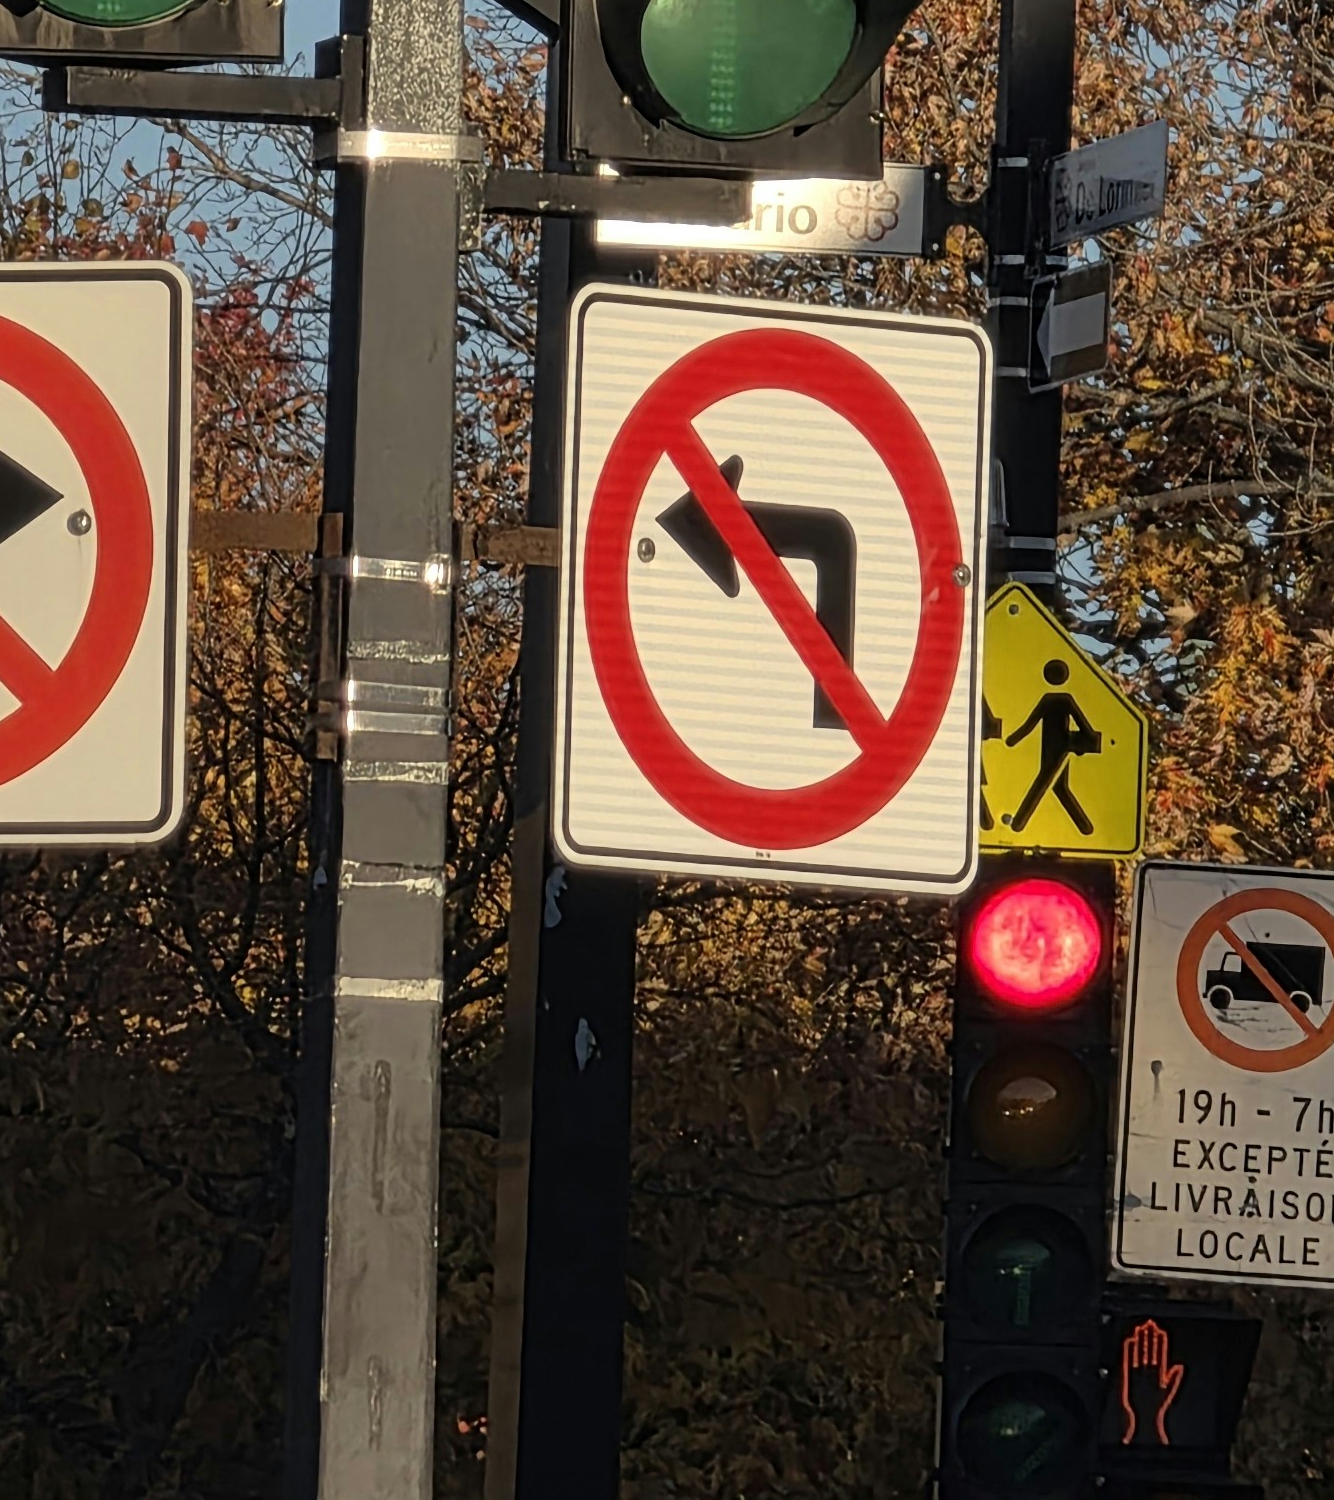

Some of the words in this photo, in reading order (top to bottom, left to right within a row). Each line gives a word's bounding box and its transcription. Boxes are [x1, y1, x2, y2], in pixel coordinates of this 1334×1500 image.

[741, 192, 818, 235] rio
[1177, 1088, 1236, 1128] 19h
[1292, 1097, 1334, 1134] 7h
[1173, 1139, 1334, 1179] EXCEPTÉ
[1176, 1228, 1320, 1266] LOCALE
